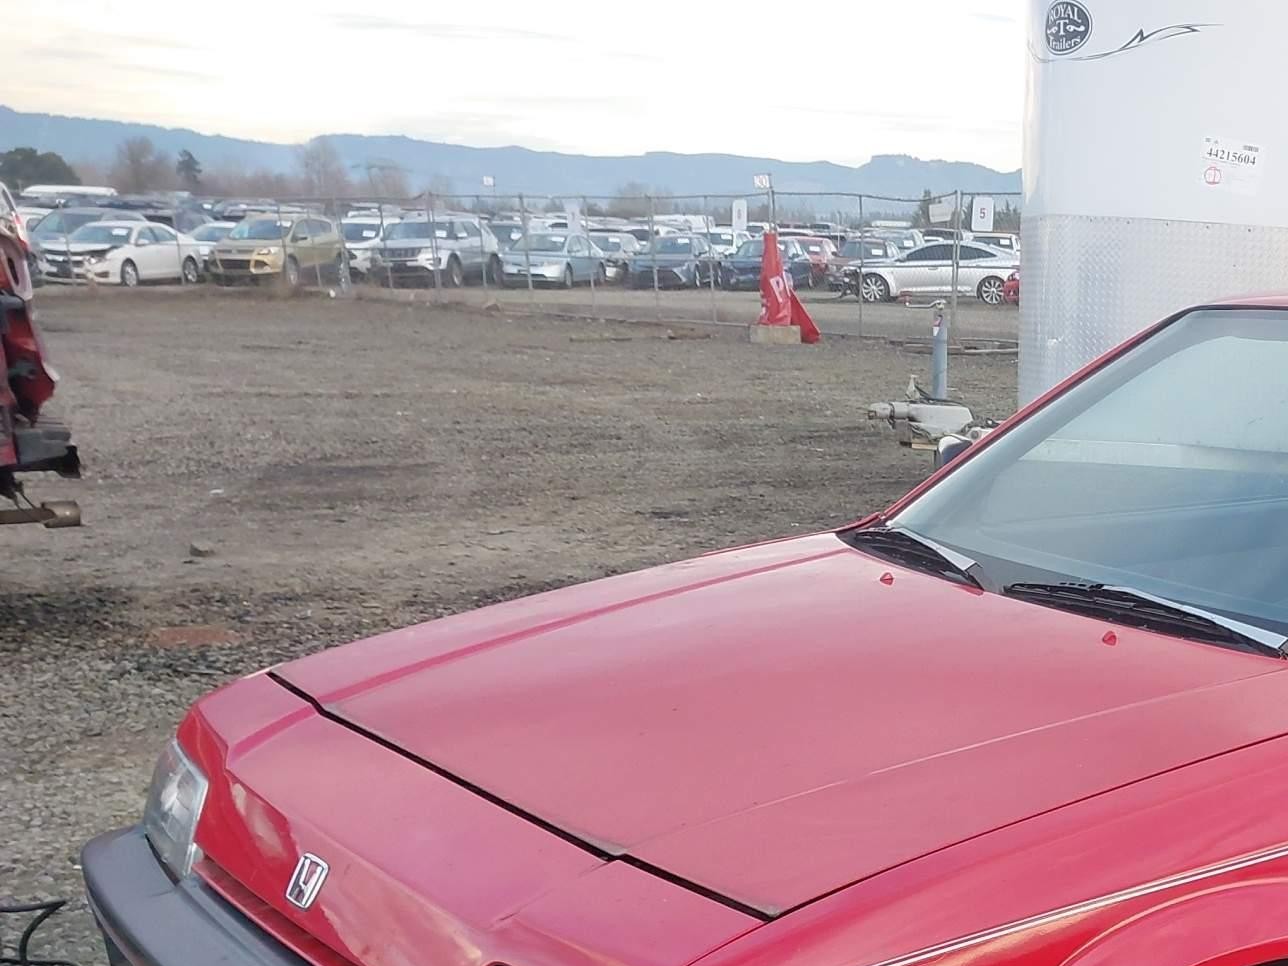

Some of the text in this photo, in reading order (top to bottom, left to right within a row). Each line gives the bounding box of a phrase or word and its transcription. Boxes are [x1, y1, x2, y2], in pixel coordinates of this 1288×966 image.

[1049, 4, 1081, 24] ROYAL
[1206, 147, 1256, 165] 44215604
[979, 207, 986, 219] 5
